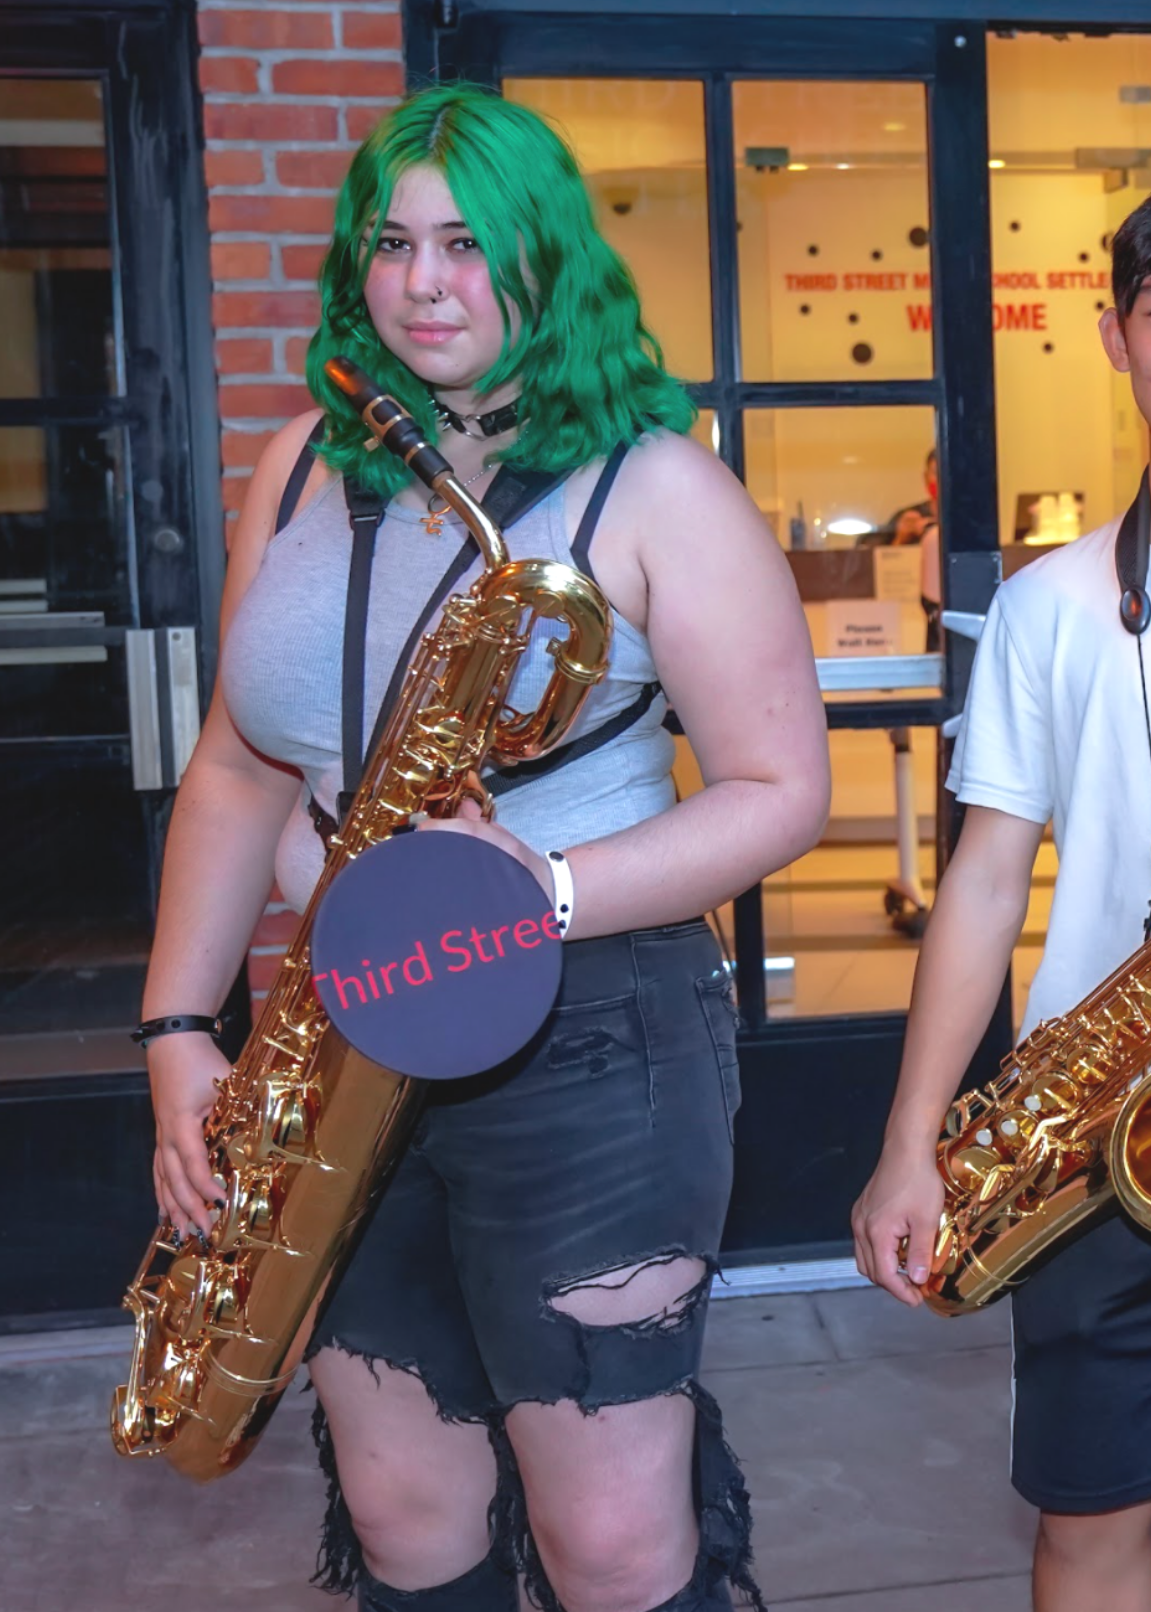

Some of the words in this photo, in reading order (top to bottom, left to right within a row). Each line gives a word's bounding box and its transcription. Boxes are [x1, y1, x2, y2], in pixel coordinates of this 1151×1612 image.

[784, 272, 838, 291] THIRD
[842, 272, 908, 291] STREET
[312, 940, 434, 1010] Third
